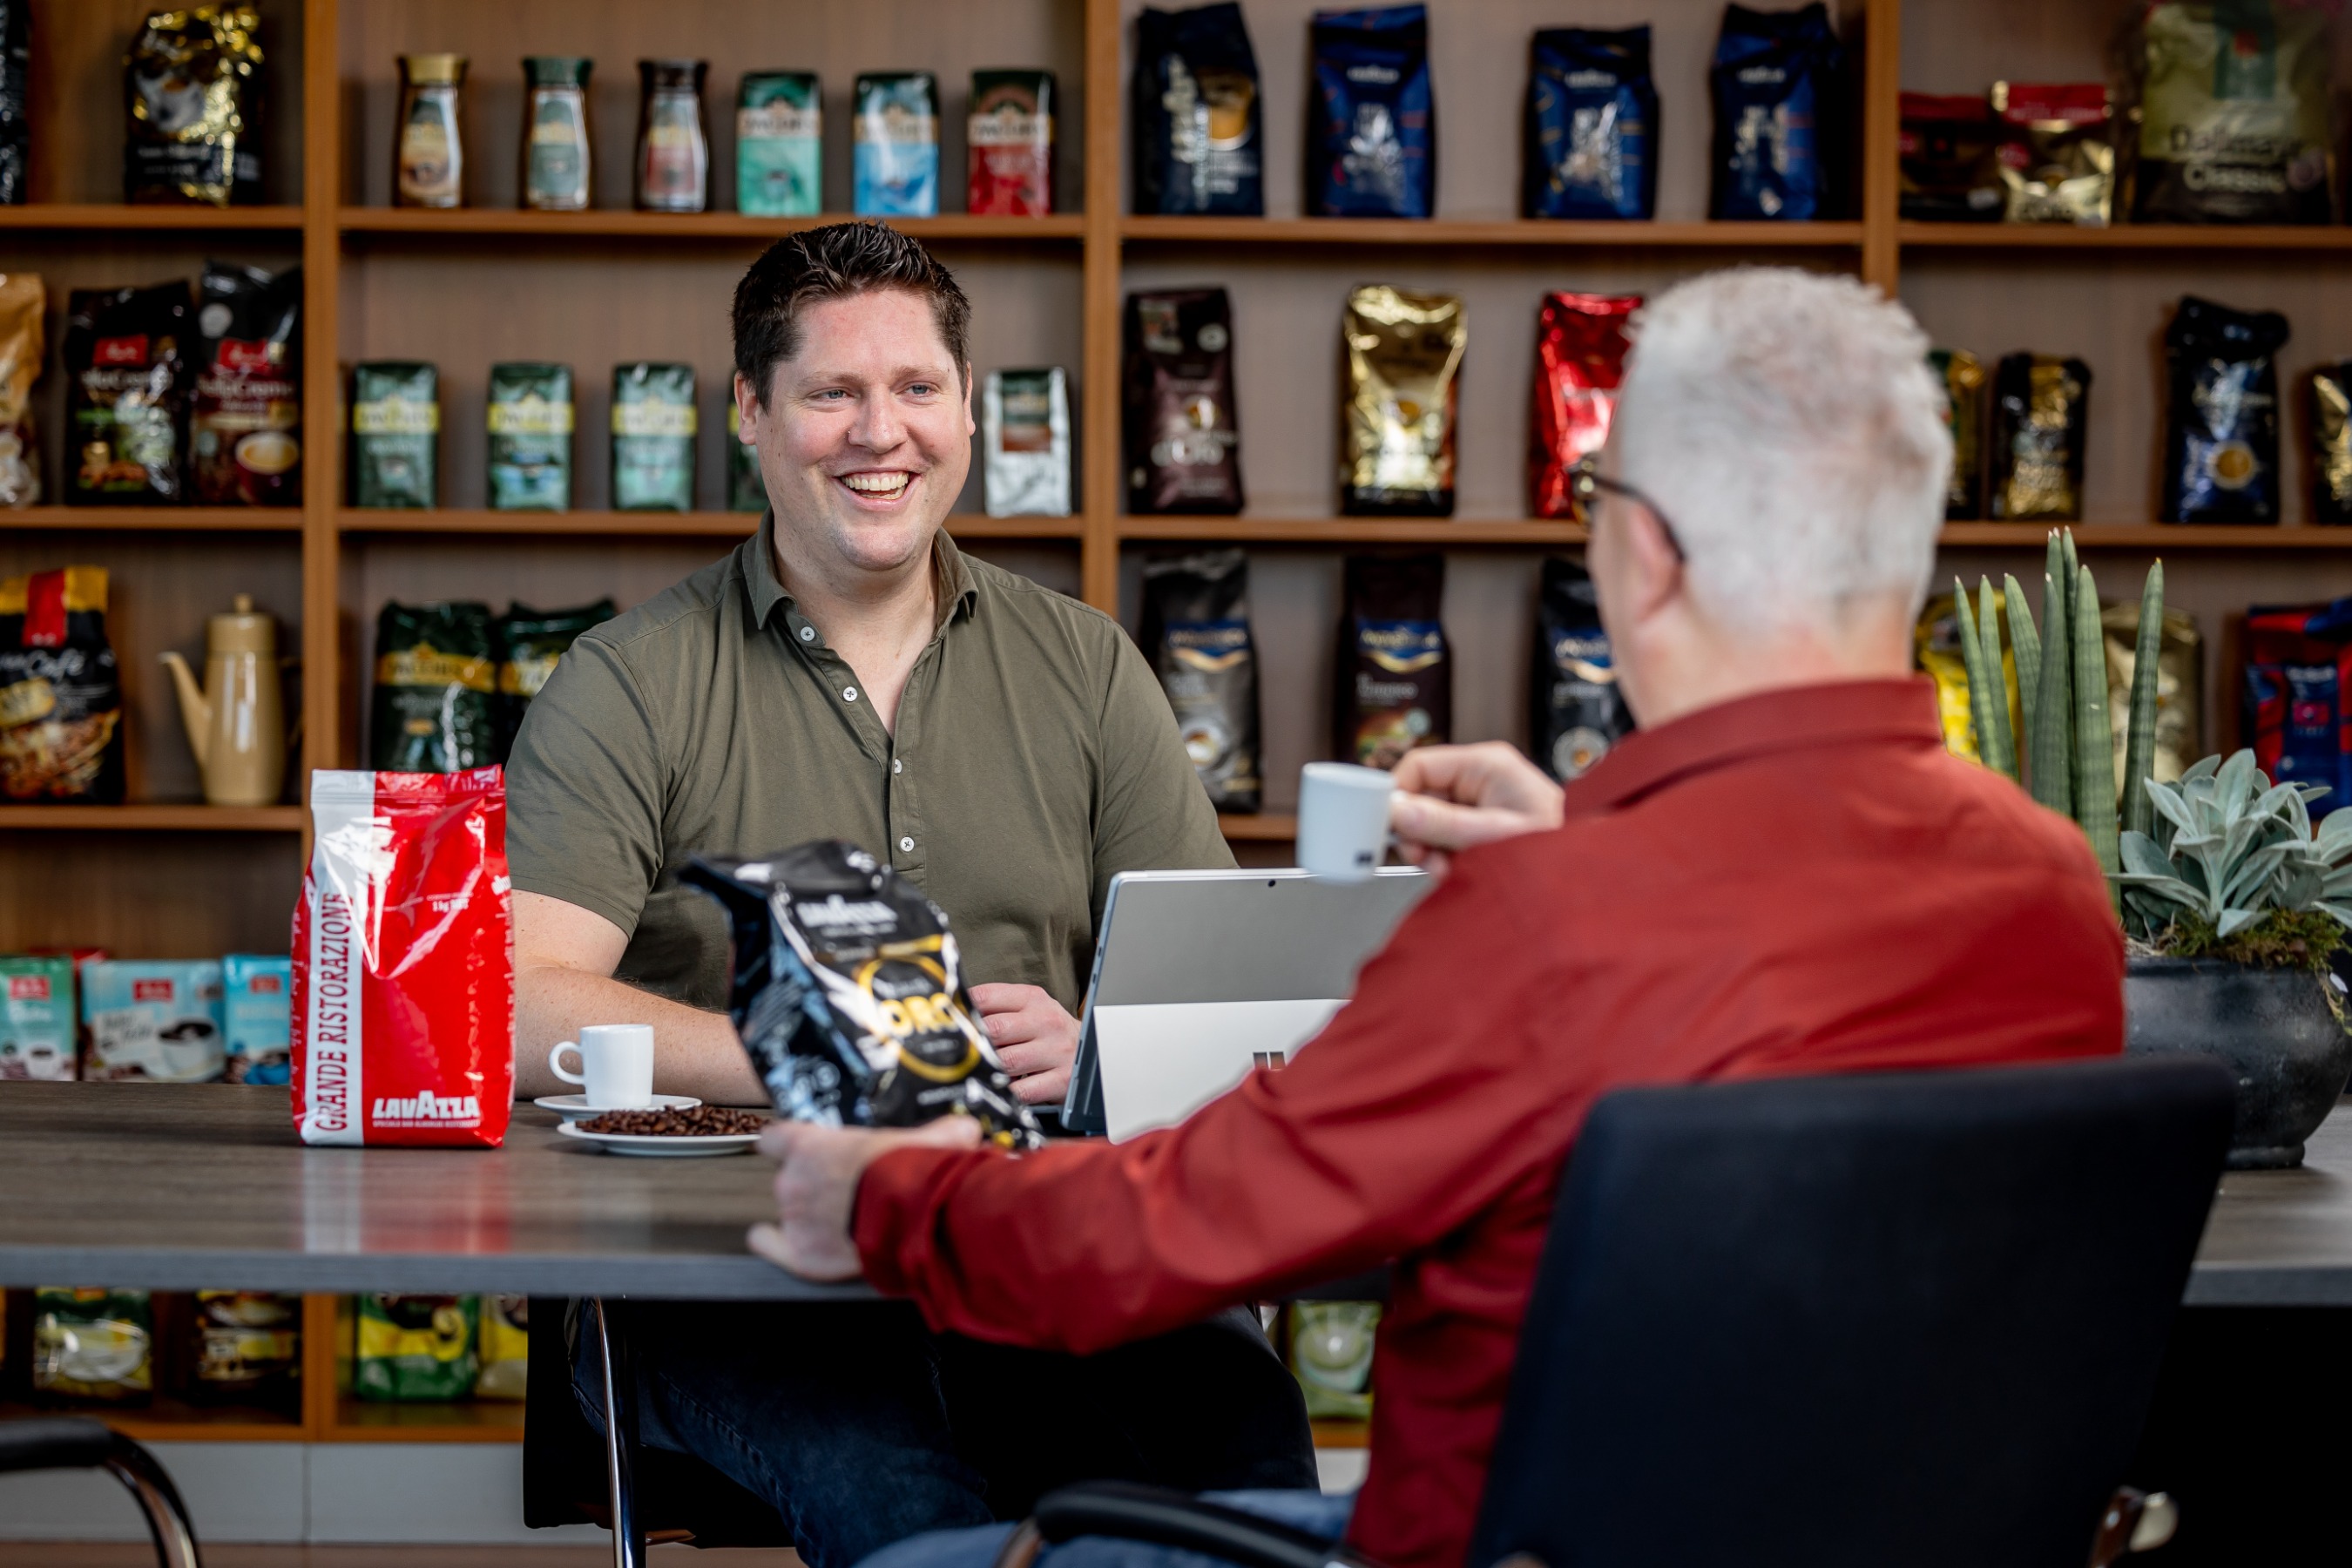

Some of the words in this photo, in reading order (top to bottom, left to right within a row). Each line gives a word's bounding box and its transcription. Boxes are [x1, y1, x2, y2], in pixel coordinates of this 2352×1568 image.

[319, 893, 353, 1044] RISTORAZIONE
[315, 1051, 348, 1132] GRANDE
[372, 1090, 480, 1119] LAVAZZA
